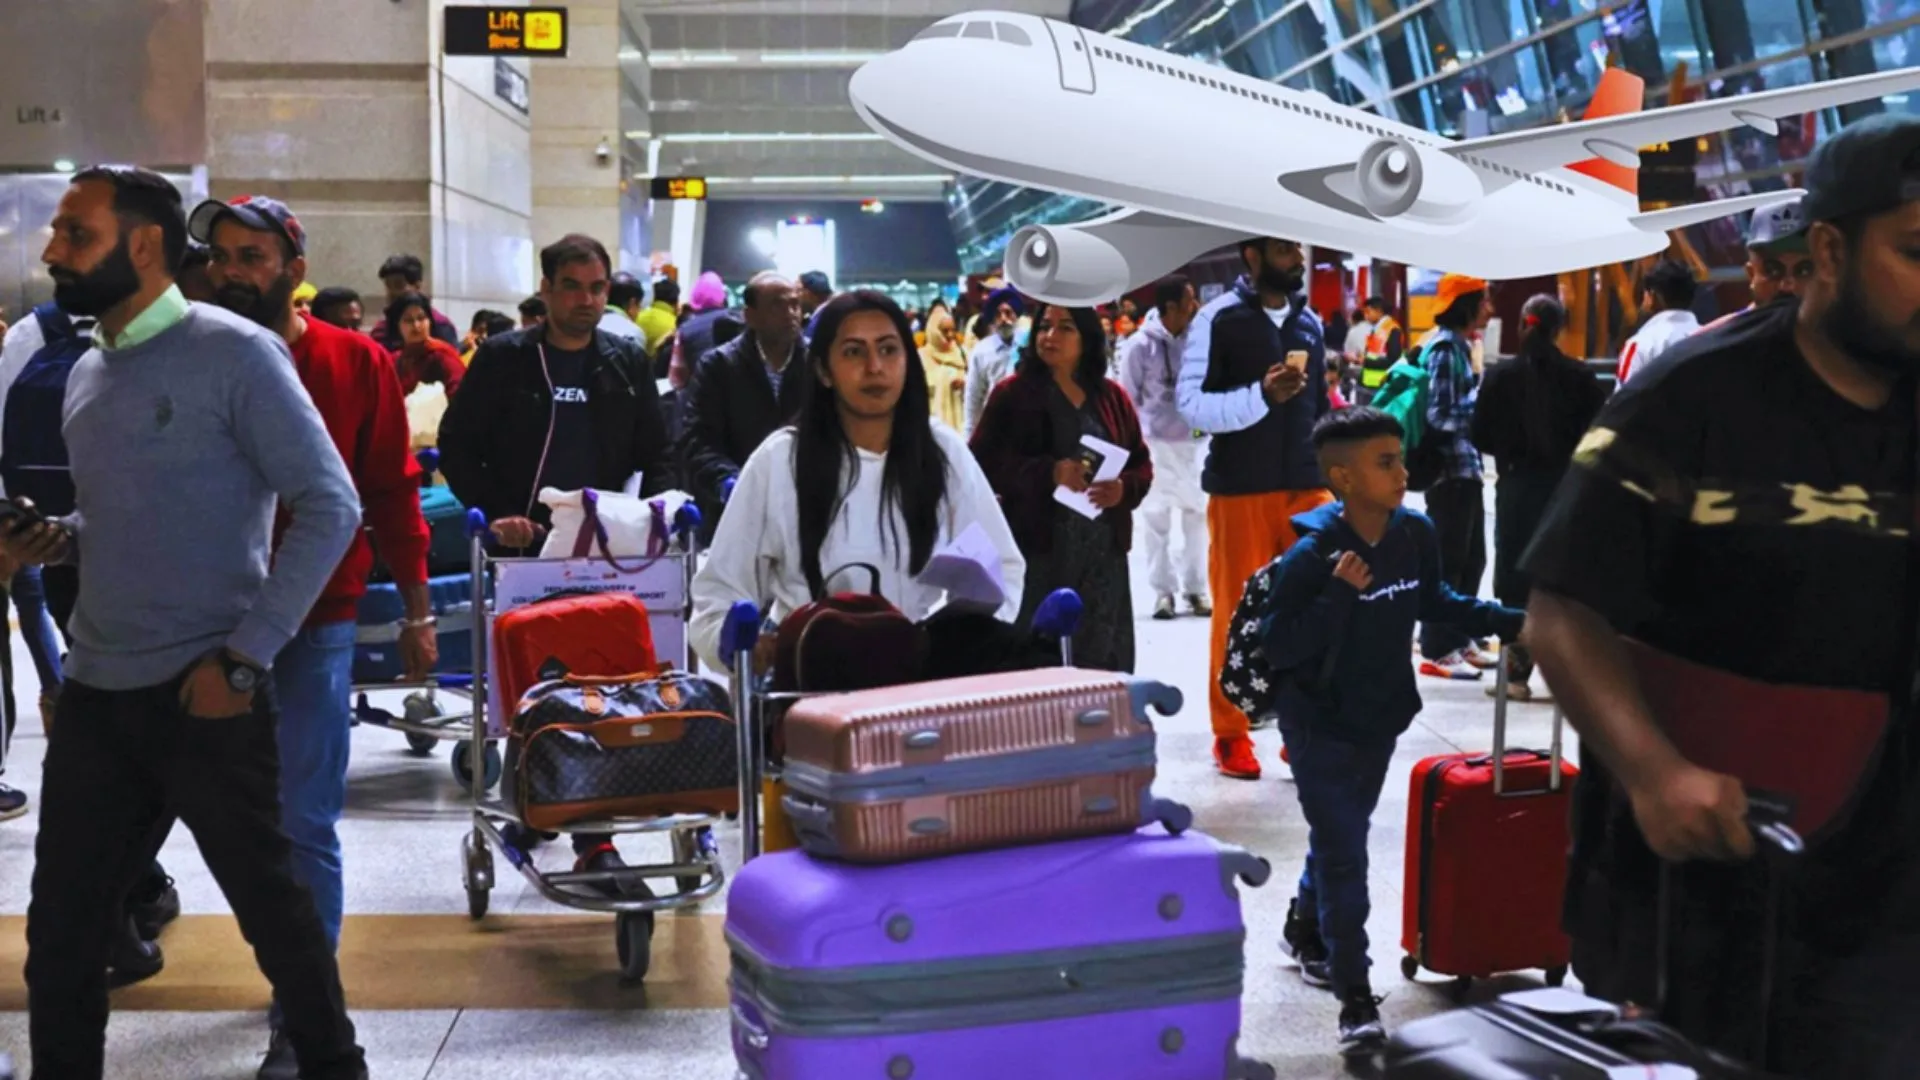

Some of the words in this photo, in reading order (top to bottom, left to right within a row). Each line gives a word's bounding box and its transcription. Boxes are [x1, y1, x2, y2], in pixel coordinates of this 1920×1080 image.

[488, 11, 520, 30] Lift
[17, 105, 46, 124] Lift
[51, 108, 61, 121] 4
